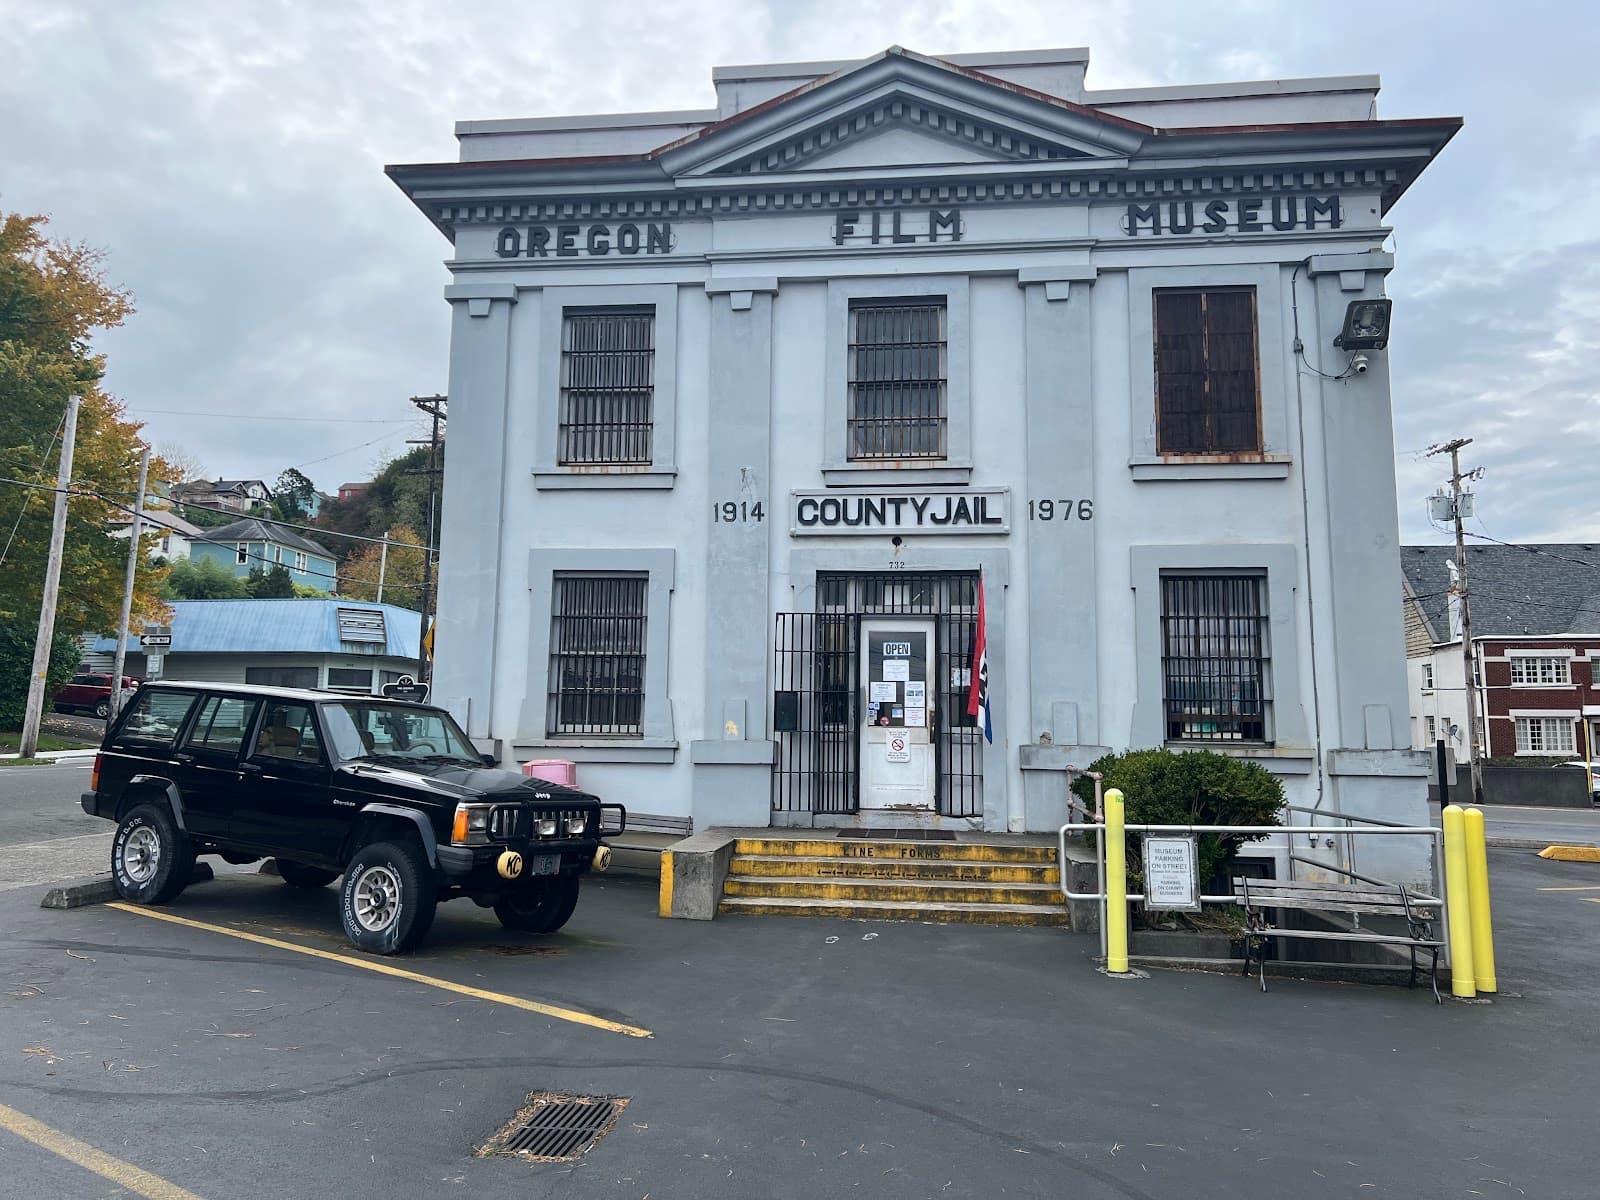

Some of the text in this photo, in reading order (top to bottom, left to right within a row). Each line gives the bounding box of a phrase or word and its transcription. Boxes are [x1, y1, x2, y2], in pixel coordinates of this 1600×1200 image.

[497, 195, 1341, 258] OREGON FILM MUSEUM
[713, 500, 765, 523] 1914
[1028, 499, 1094, 522] 1976
[888, 561, 905, 569] 732
[885, 643, 909, 655] OPEN
[599, 849, 612, 869] KC
[843, 847, 941, 859] LINE FORMS
[506, 854, 521, 876] KC
